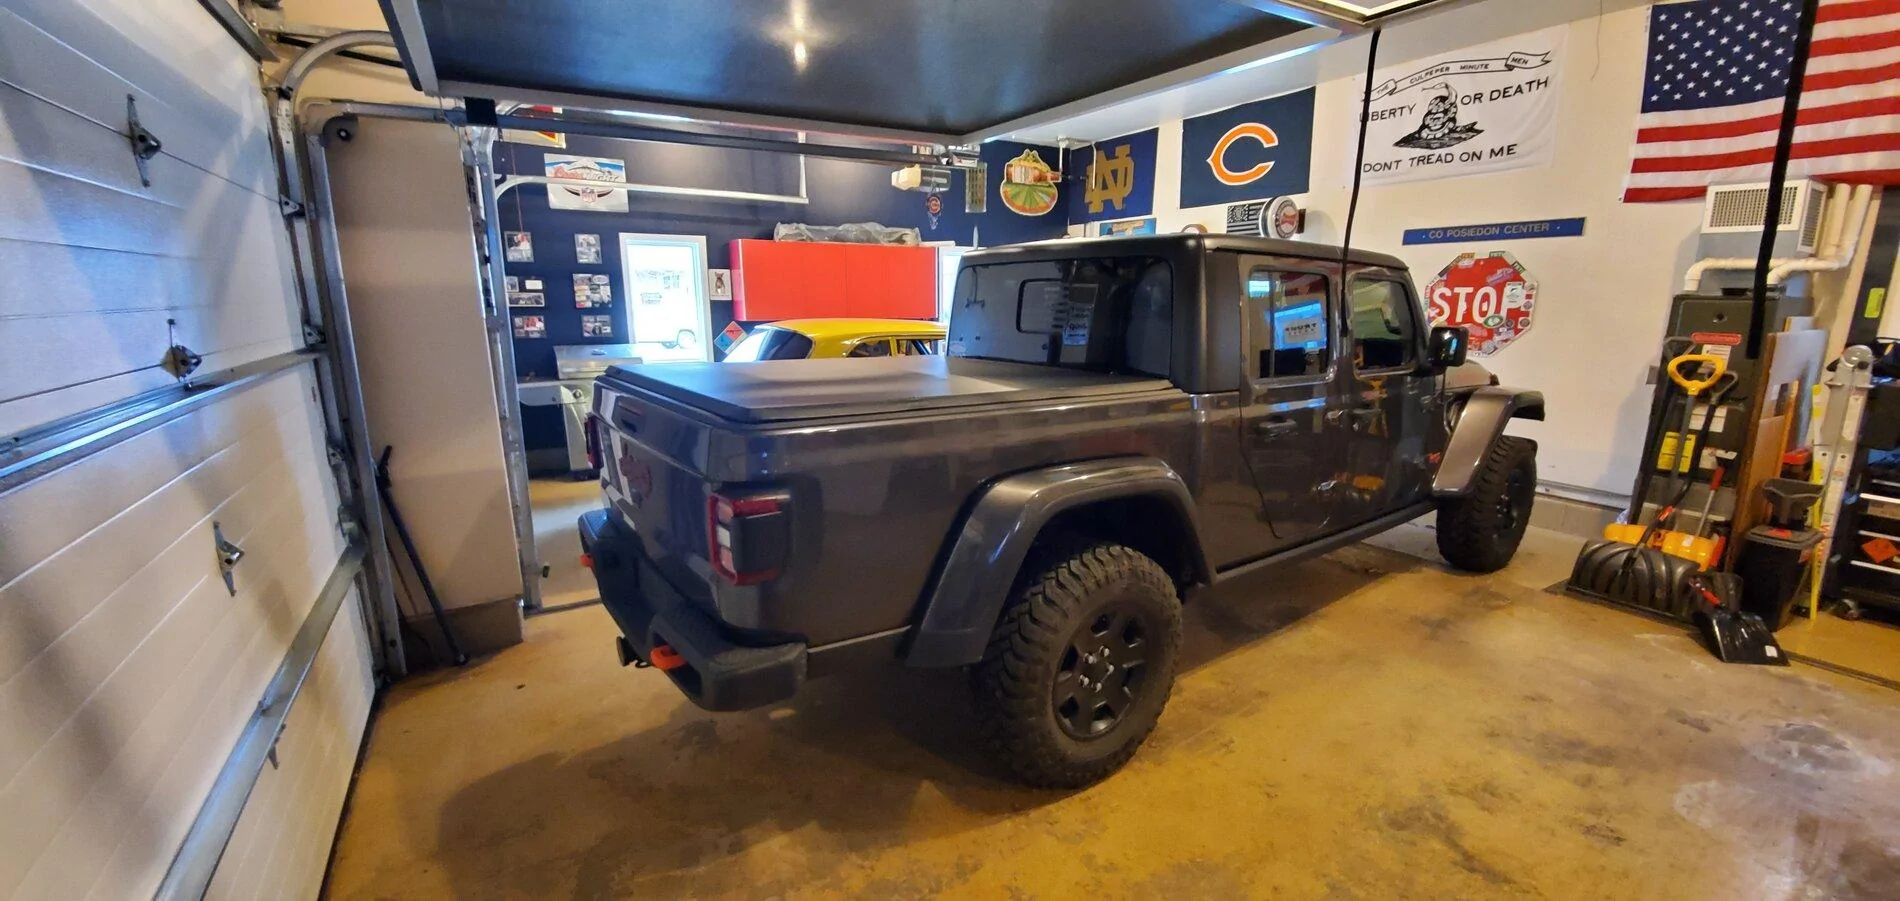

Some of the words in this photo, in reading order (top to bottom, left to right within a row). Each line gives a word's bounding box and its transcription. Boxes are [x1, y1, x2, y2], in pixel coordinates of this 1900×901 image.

[1376, 84, 1390, 95] THE
[1409, 66, 1451, 85] CULPEPER
[1459, 63, 1490, 71] MINUTE
[1510, 56, 1529, 65] MEN
[1460, 92, 1484, 106] OR
[1489, 76, 1550, 102] DEATH
[1206, 122, 1279, 186] C
[1363, 159, 1402, 173] DONT
[1408, 152, 1454, 168] TREAD
[1459, 150, 1483, 162] ON
[1489, 143, 1518, 159] ME
[1428, 229, 1444, 239] CO
[1446, 226, 1500, 238] POSIEDON
[1504, 222, 1550, 234] CENTER
[1432, 286, 1525, 323] STOP
